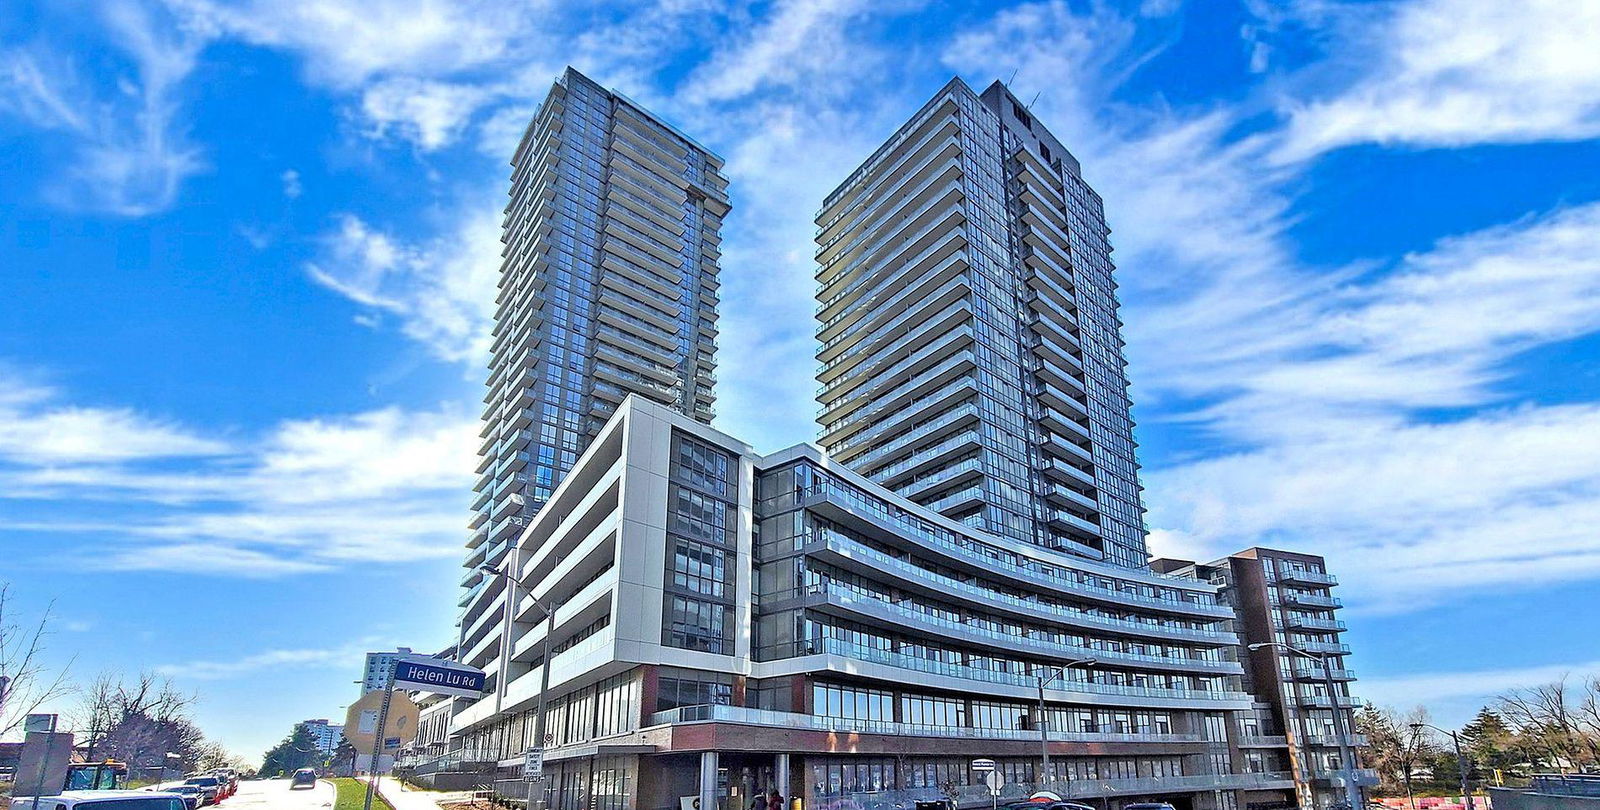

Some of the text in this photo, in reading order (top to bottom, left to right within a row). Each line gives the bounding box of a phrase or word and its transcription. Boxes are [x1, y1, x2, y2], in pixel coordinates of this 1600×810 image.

[407, 666, 476, 687] Helen Lu Rd
